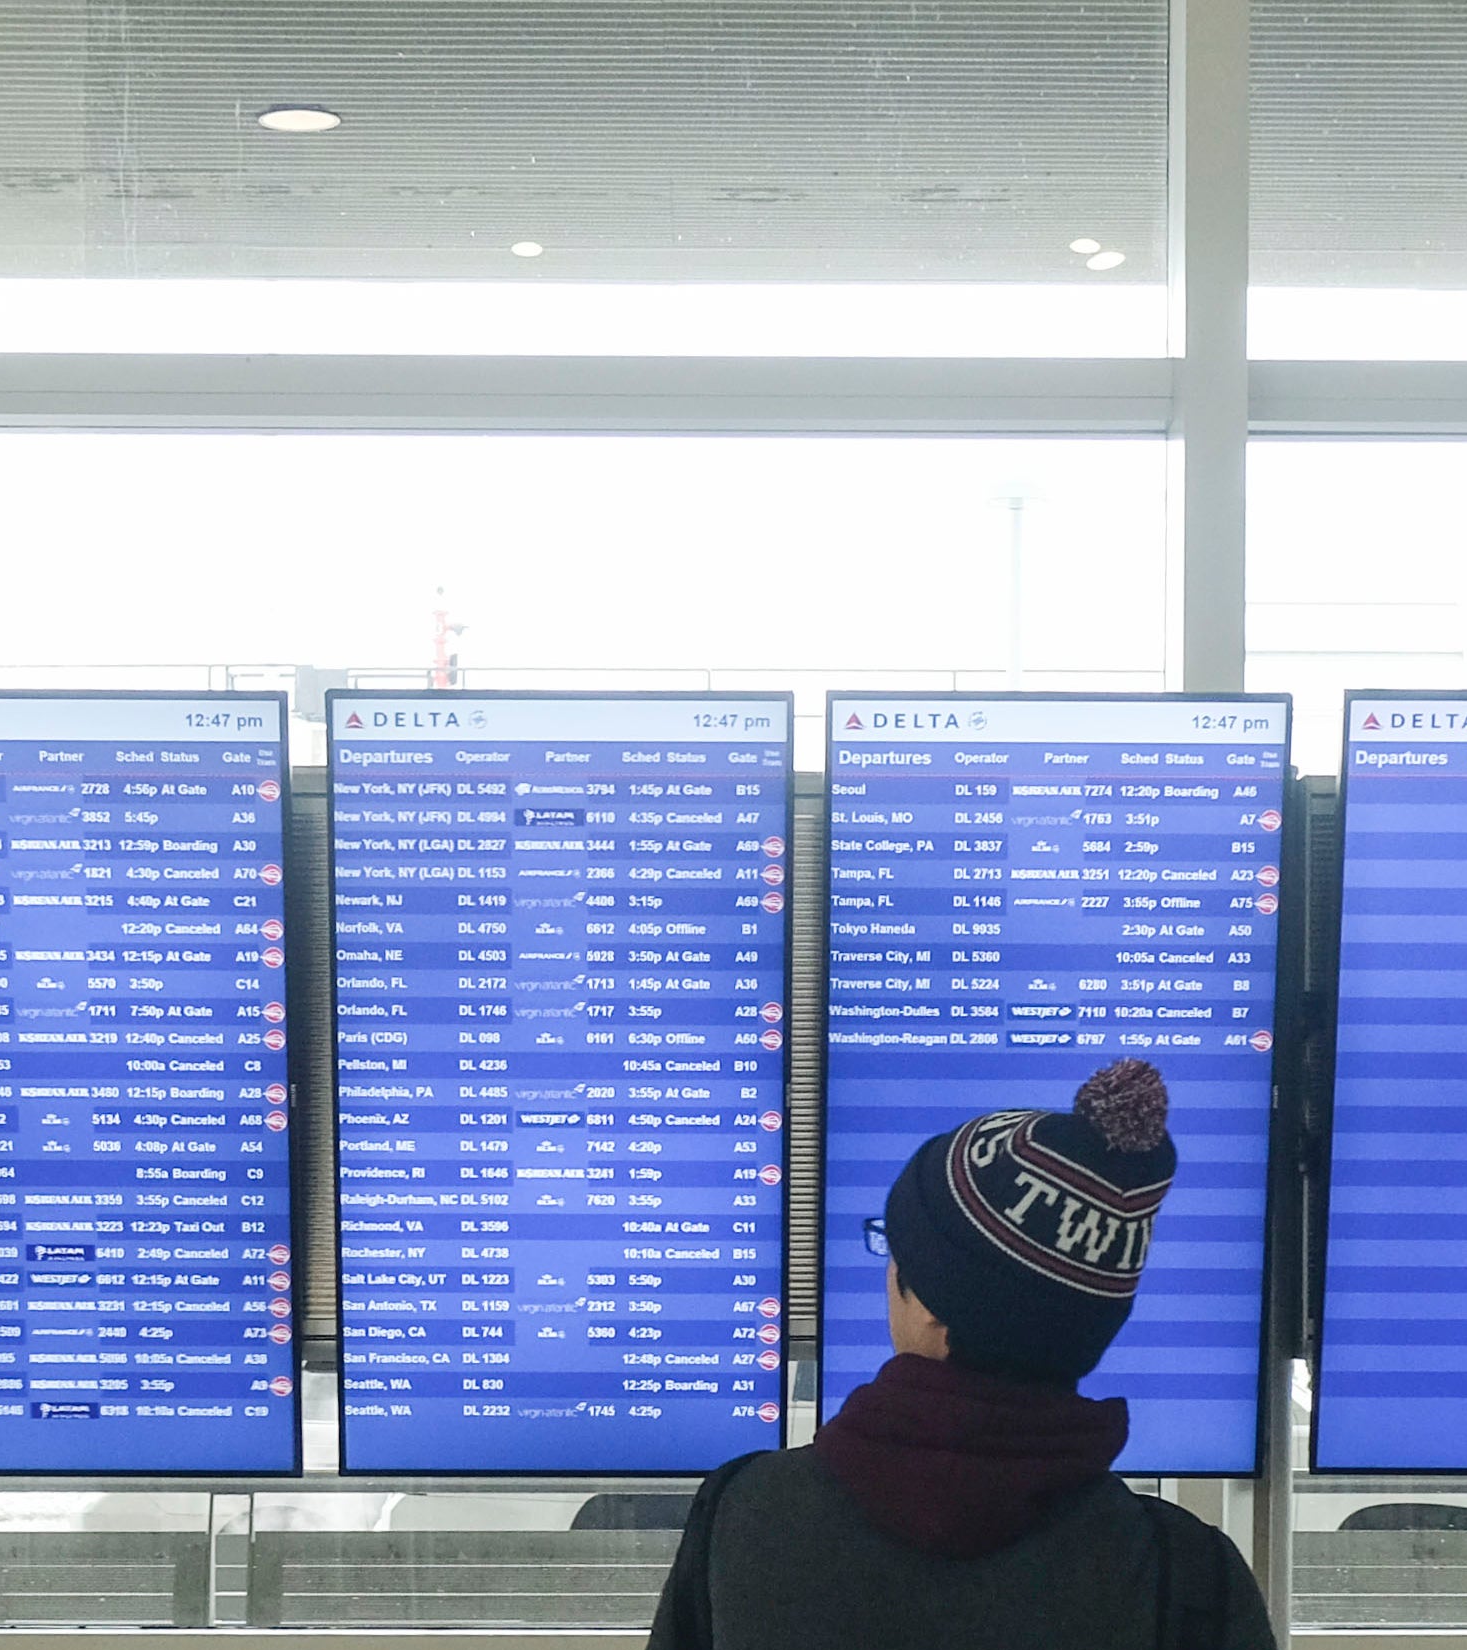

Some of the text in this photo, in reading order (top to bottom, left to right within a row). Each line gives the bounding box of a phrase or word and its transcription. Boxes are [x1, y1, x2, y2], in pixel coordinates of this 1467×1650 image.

[186, 714, 262, 730] 12:47 pm
[374, 712, 459, 727] DELTA
[694, 714, 770, 731] 12:47 pm
[874, 713, 958, 728] DELTA
[1193, 716, 1269, 732] 12:47 pm
[39, 751, 84, 762] Partner
[116, 751, 154, 762] Sched
[161, 752, 199, 762] Status
[222, 752, 251, 762] Gate
[340, 749, 433, 767] Departures
[456, 751, 510, 764] Operator
[546, 751, 591, 762] Partner
[622, 752, 660, 762] Sched
[667, 752, 706, 763] Status
[728, 752, 757, 763] Gate
[839, 750, 931, 768] Departures
[955, 752, 1009, 765] Operator
[1044, 753, 1089, 763] Partner
[1121, 753, 1158, 764] Sched
[1165, 753, 1204, 764] Status
[1227, 754, 1255, 764] Gate
[1356, 750, 1448, 768] Departures
[831, 923, 1252, 938] Tokyo Haneda DL 9935 2:30p At Gate A50
[831, 951, 1251, 964] Traverse City, MI DL 5360 10:05a Canceled A33
[127, 1060, 165, 1071] 10:00a
[169, 1060, 224, 1071] Canceled
[245, 1061, 261, 1071] C8
[136, 1168, 168, 1178] 8:55a
[173, 1168, 226, 1181] Boarding
[247, 1169, 263, 1179] C9
[344, 1379, 754, 1392] Seattle, WA DL 830 12:25p Boarding A31
